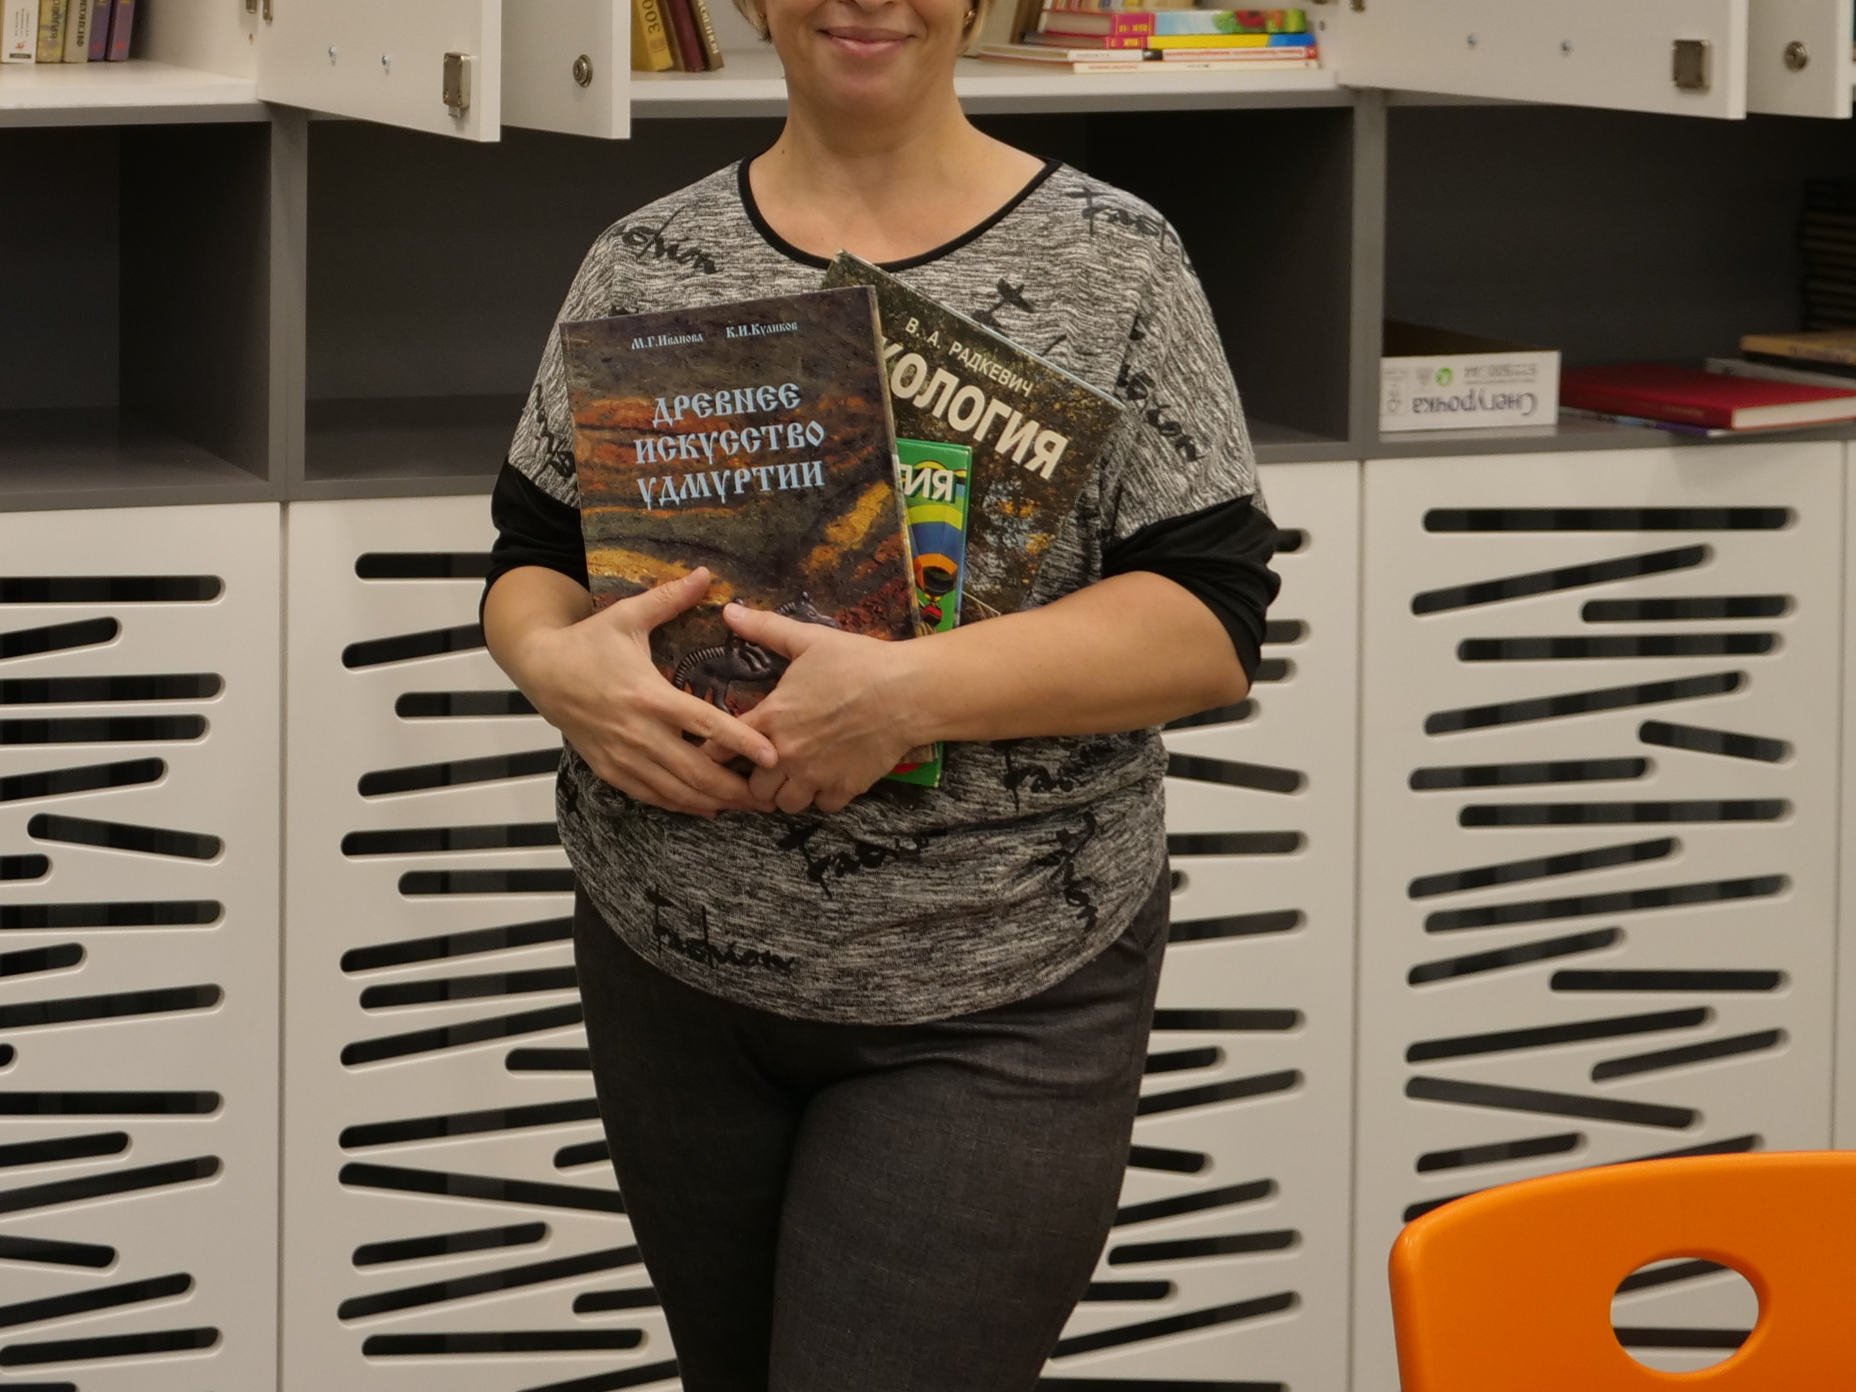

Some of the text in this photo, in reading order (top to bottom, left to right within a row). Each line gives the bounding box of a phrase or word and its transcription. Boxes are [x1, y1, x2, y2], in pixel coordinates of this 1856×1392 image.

[631, 329, 704, 351] М.Г.Иванова
[726, 320, 798, 341] К.И.Куликов
[906, 317, 1035, 399] В. А. РАДКЕВИЧ
[652, 382, 802, 429] ДРЕВНЕЕ
[1412, 388, 1538, 417] Снегурочка
[634, 421, 825, 467] ИСКУССТВО
[636, 462, 825, 509] УДМУРТИИ
